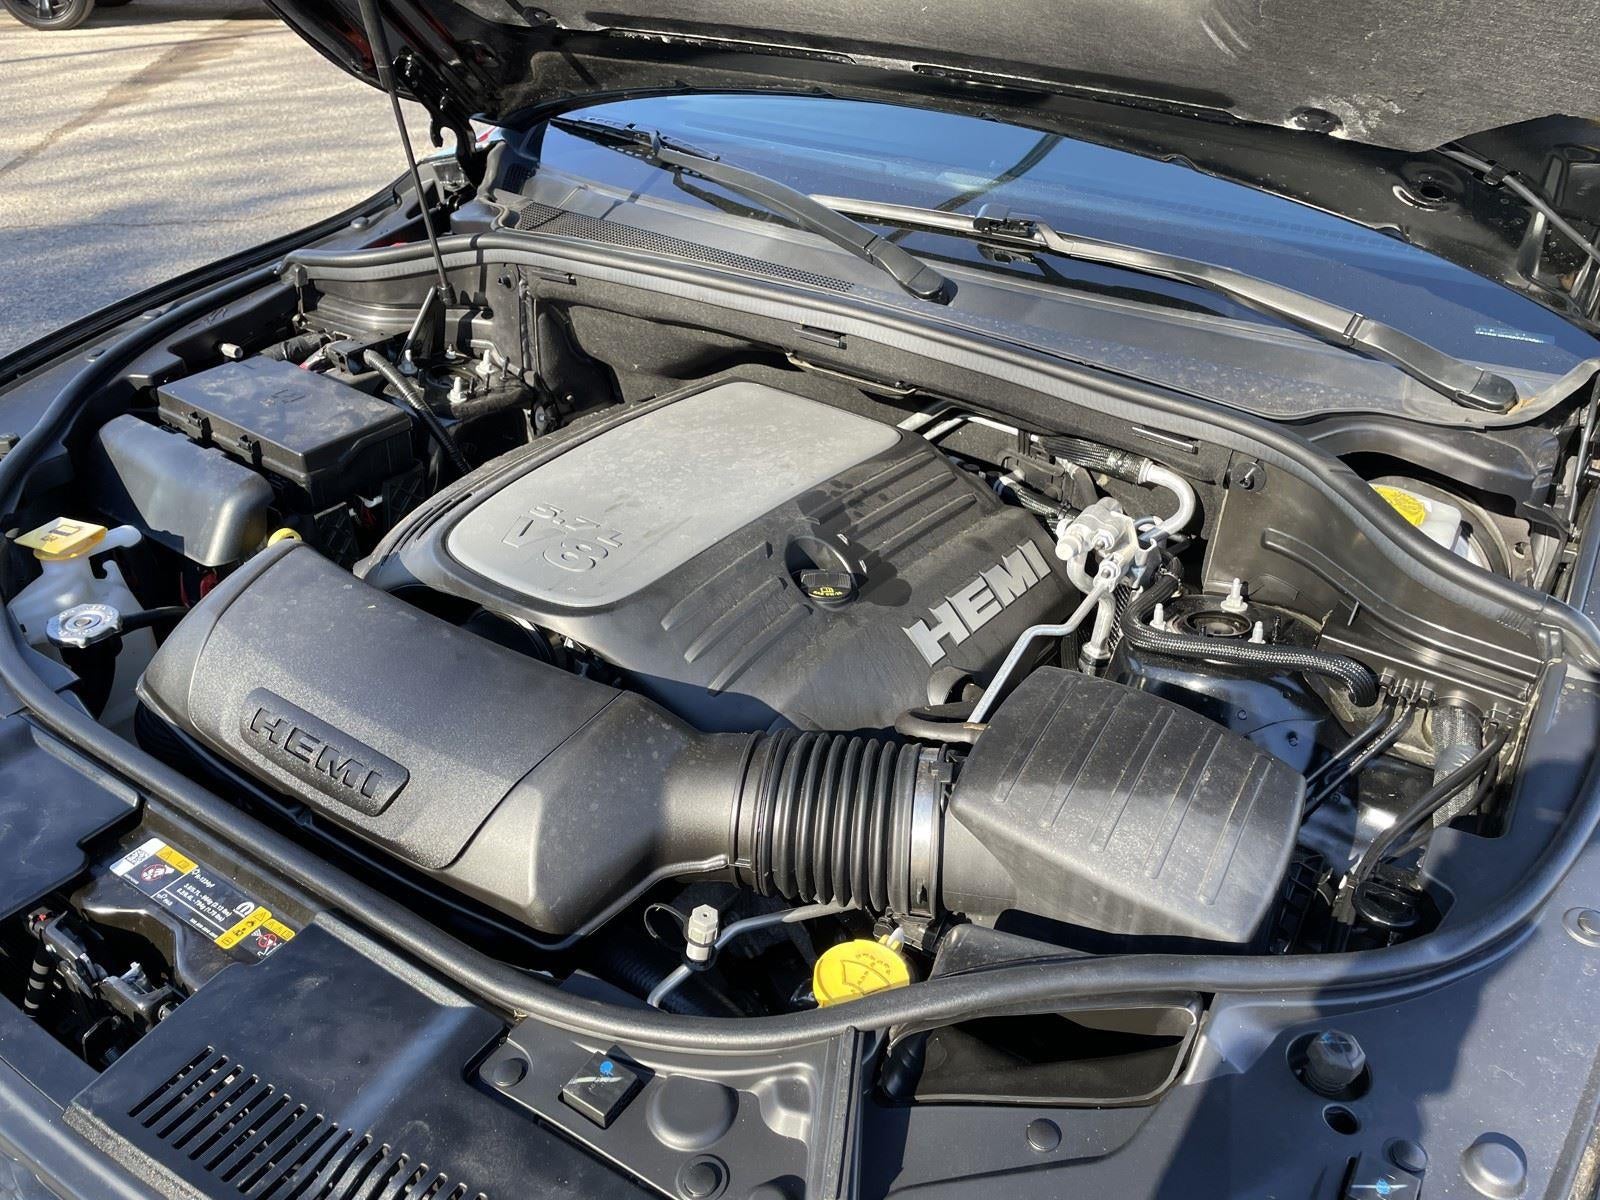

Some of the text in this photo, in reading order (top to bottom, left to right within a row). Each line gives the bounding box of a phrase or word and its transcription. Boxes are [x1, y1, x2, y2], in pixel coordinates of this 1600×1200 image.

[501, 514, 609, 573] V8
[529, 502, 625, 549] 5.7L
[902, 538, 1053, 668] HEMI
[250, 707, 383, 799] HEMI
